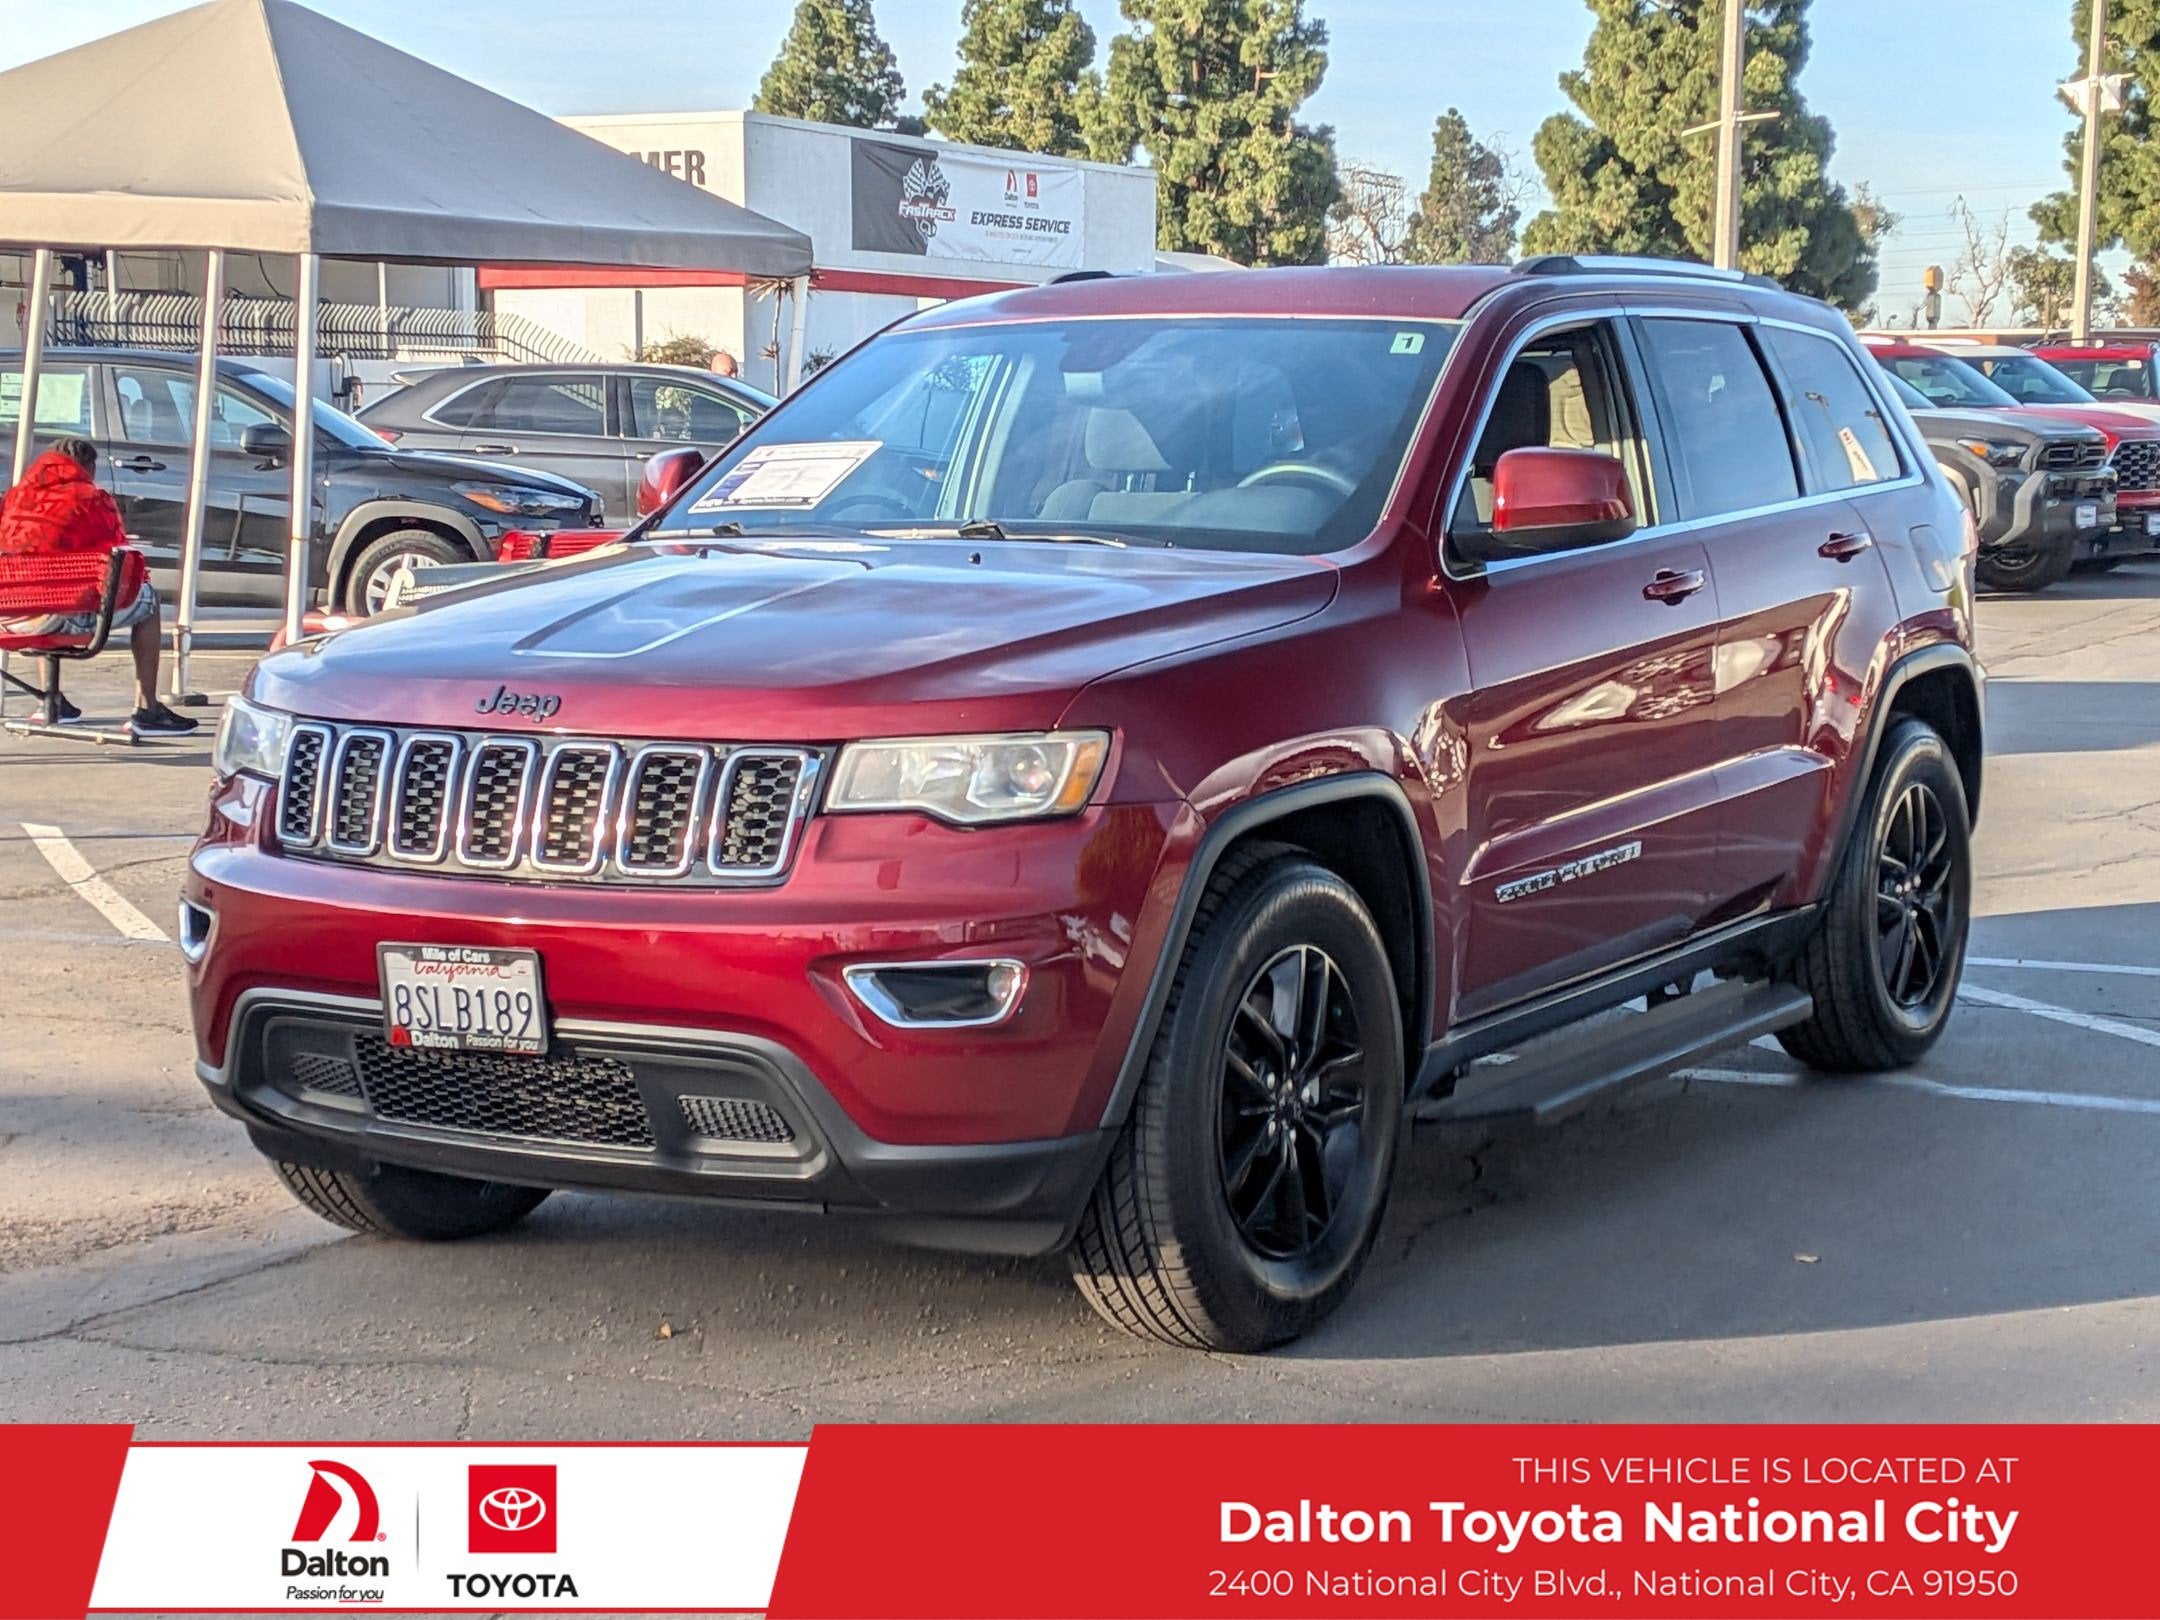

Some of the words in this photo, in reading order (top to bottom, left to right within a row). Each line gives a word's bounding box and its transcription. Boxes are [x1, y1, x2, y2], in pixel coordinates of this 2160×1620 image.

[970, 210, 1024, 230] EXPRESS
[1024, 217, 1071, 234] SERVICE
[475, 685, 562, 724] Jeep
[447, 948, 461, 962] of
[462, 949, 491, 964] Cars
[414, 960, 512, 984] California
[395, 984, 533, 1036] 8SLB189
[410, 1030, 459, 1049] Dalton
[465, 1034, 502, 1048] Passion
[502, 1036, 518, 1048] for
[519, 1040, 539, 1051] you
